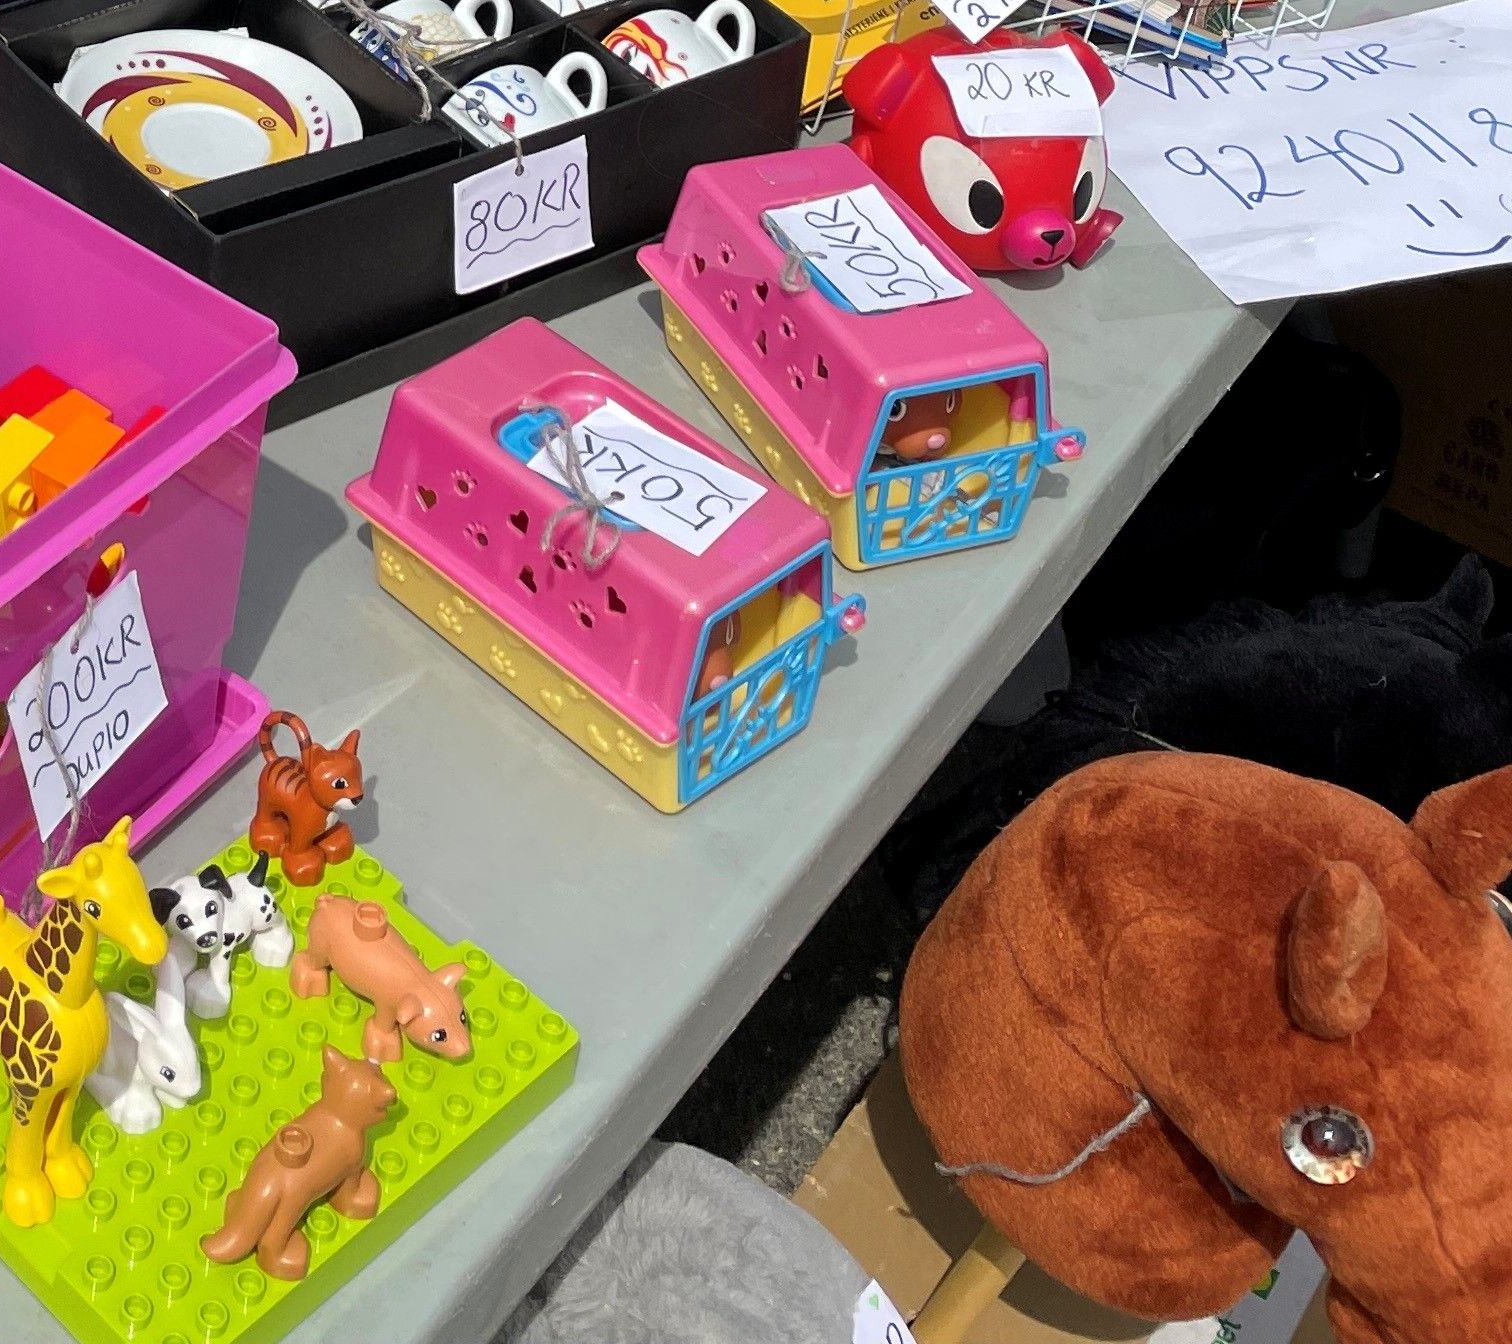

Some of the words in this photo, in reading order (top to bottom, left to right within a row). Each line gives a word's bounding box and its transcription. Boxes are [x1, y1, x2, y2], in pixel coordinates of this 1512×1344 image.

[967, 3, 1000, 28] 2
[965, 62, 1012, 101] 20
[1023, 70, 1070, 98] KR
